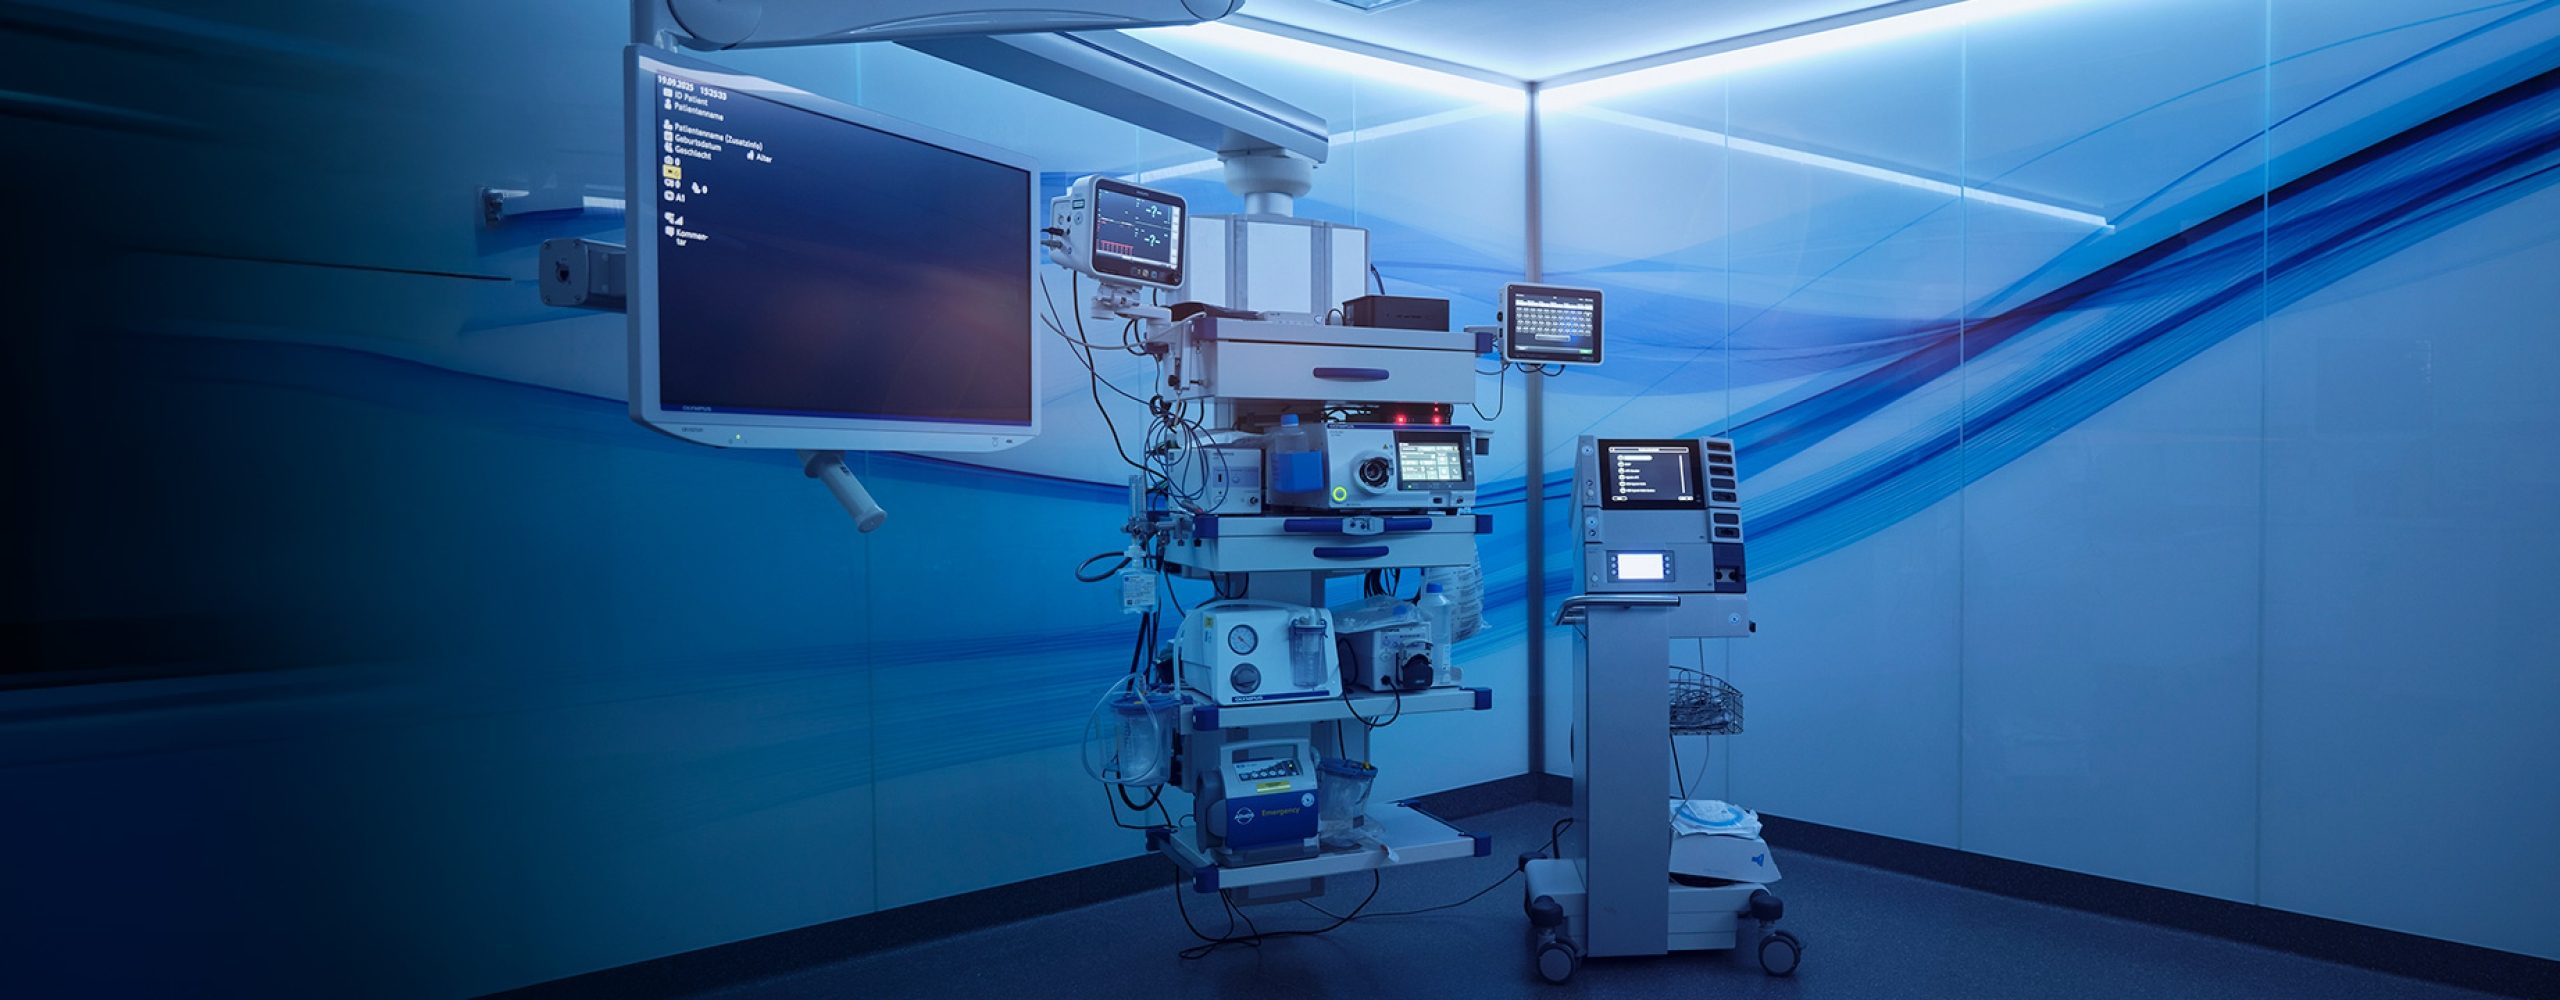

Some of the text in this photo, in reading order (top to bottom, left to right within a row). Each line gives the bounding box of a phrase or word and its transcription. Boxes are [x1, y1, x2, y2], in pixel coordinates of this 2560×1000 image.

[684, 93, 708, 106] Patient
[674, 102, 724, 121] Patientenname
[674, 122, 724, 141] Patientenname
[674, 134, 722, 151] Geburtsdatum
[674, 145, 712, 160] Geschlecht
[756, 153, 773, 163] Alter
[676, 228, 709, 241] Kommen-
[676, 238, 687, 246] tar
[1261, 807, 1301, 817] Emergency
